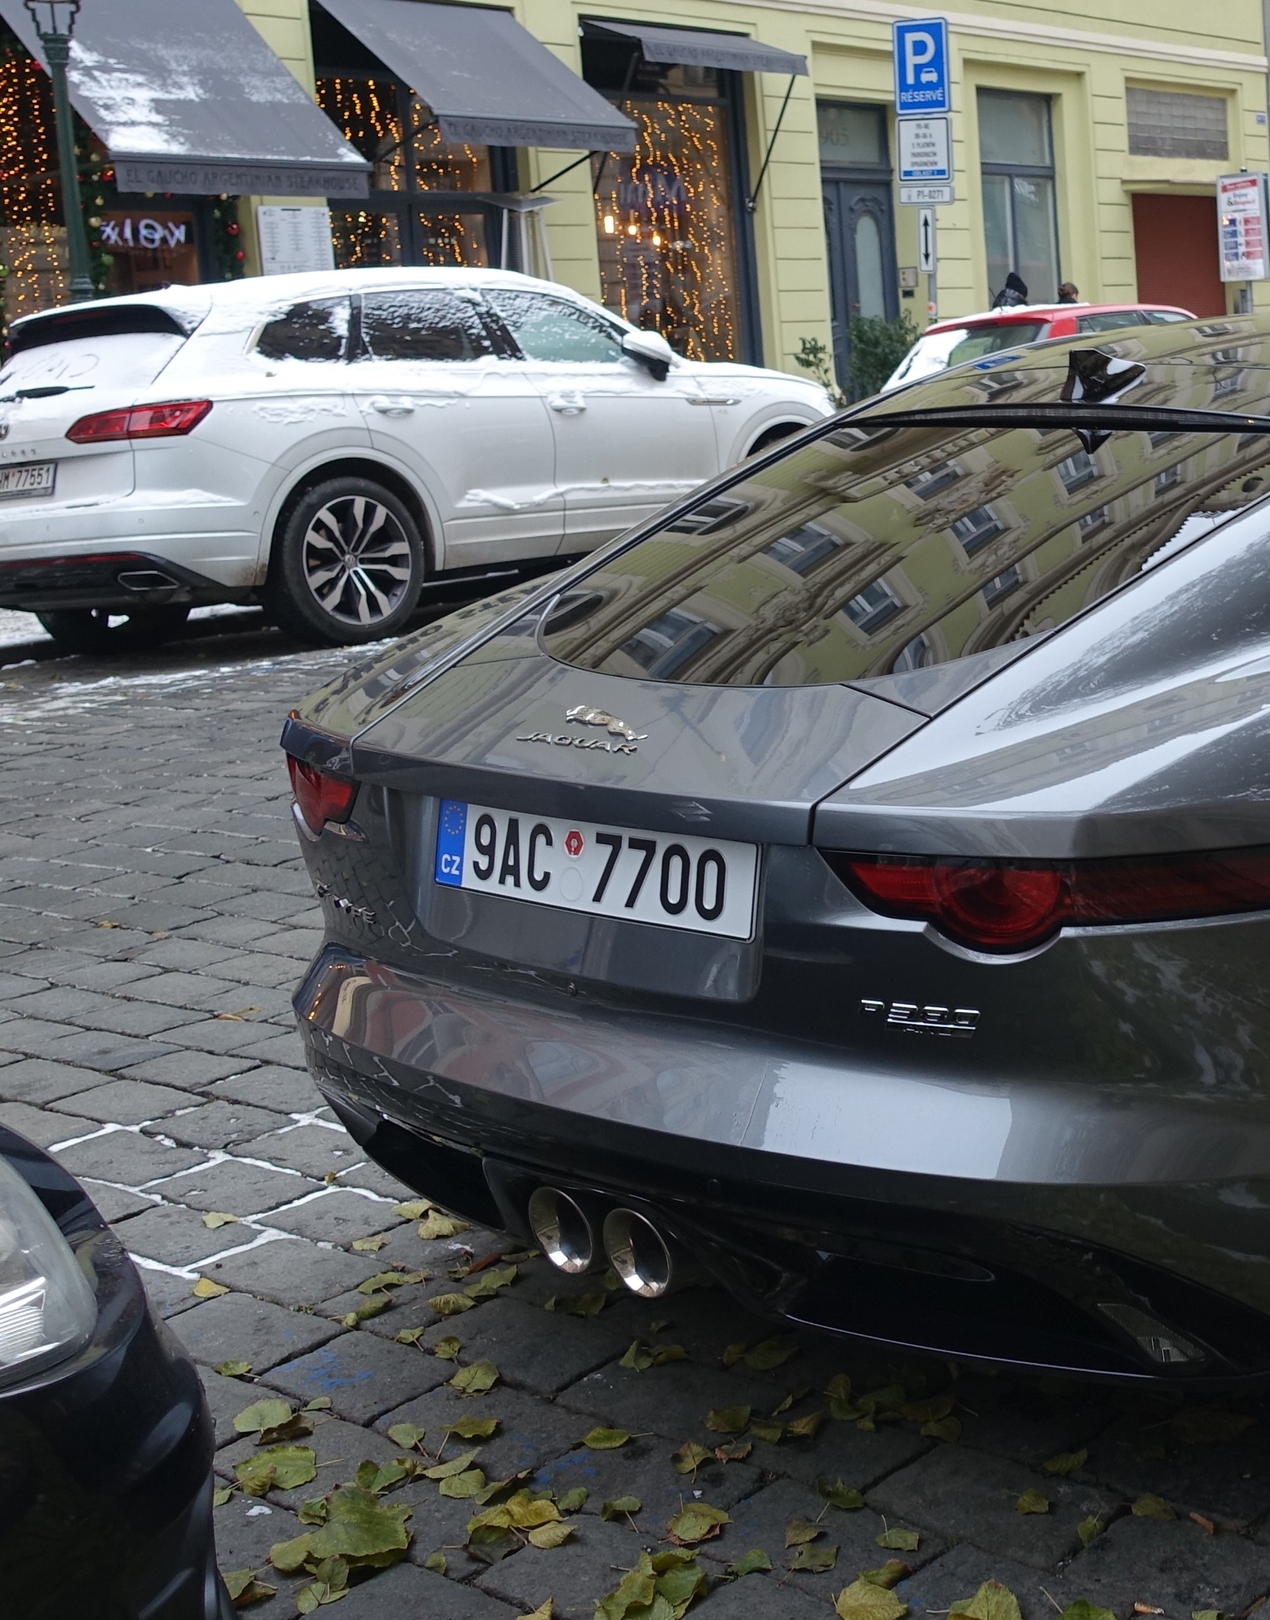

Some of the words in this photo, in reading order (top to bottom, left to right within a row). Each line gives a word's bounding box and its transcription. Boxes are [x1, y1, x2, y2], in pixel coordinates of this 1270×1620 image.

[904, 31, 936, 85] P
[900, 87, 944, 103] RÉSERVÉ
[126, 168, 142, 184] EL
[150, 169, 198, 185] GAUCHO
[203, 171, 283, 188] ARGENTINIAN
[287, 174, 360, 191] STEAKHOUSE
[15, 466, 51, 488] 77551
[516, 732, 638, 755] JAGUAR
[441, 854, 460, 876] CZ
[473, 813, 553, 892] 9AC
[592, 832, 726, 921] 7700
[859, 998, 981, 1026] P380
